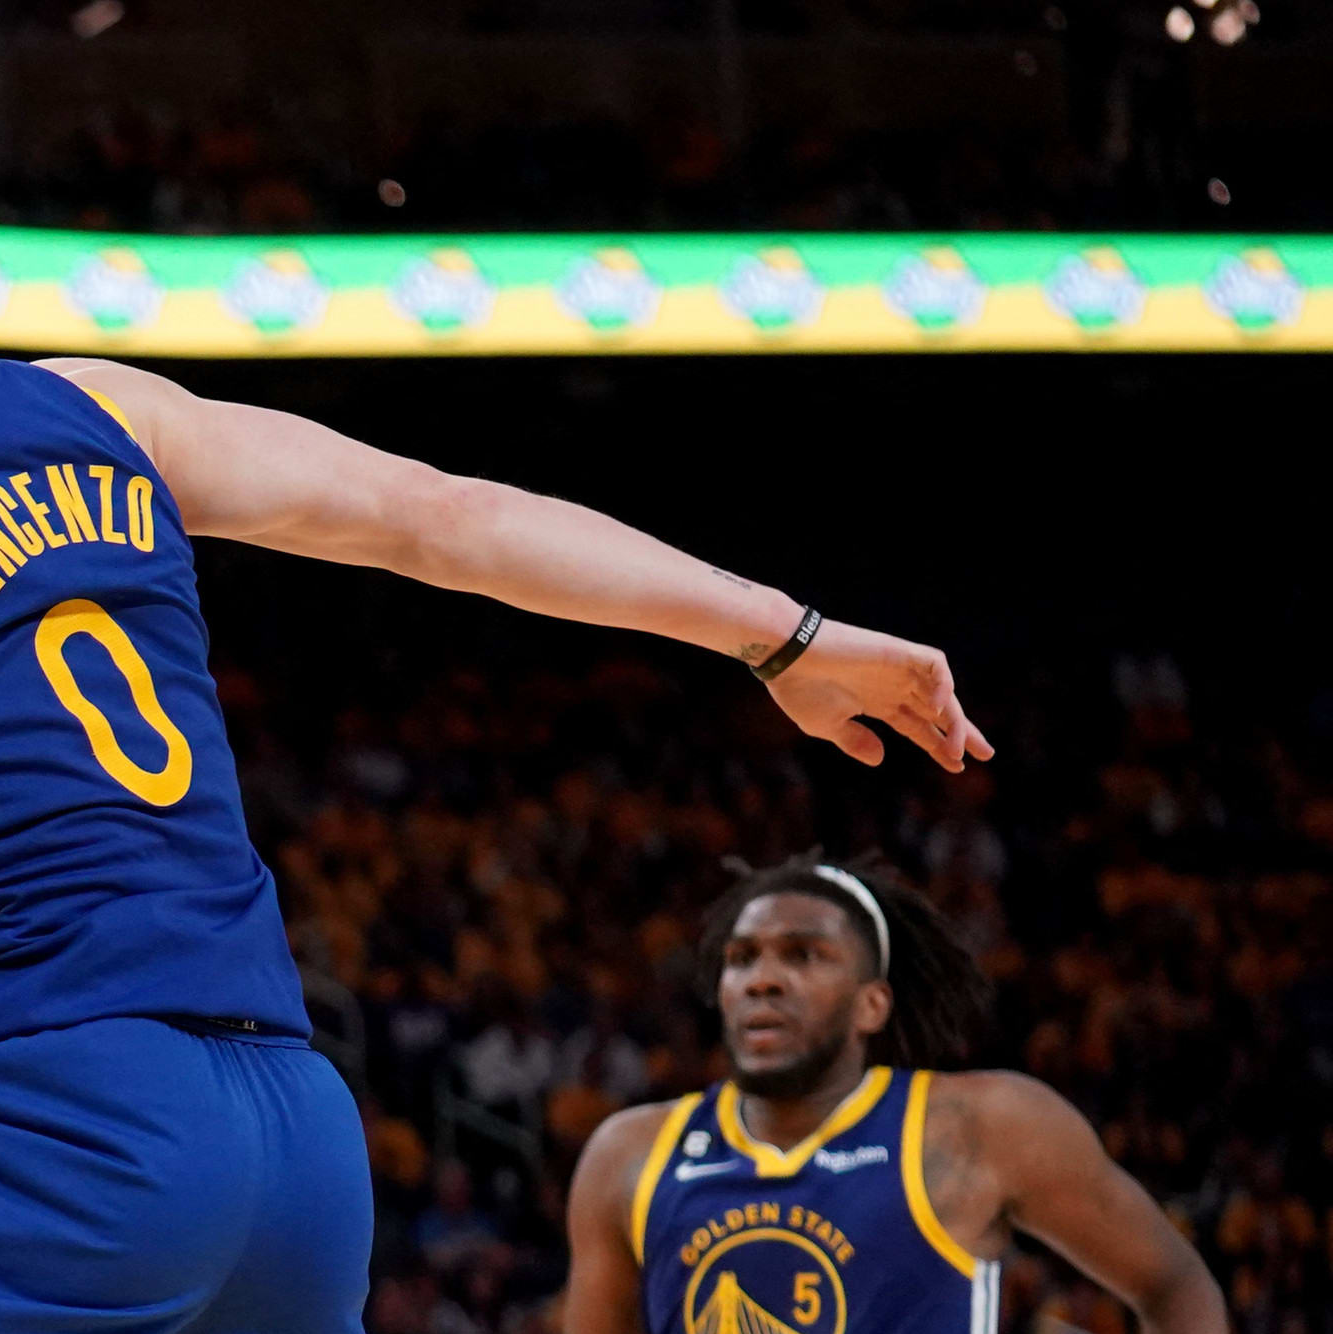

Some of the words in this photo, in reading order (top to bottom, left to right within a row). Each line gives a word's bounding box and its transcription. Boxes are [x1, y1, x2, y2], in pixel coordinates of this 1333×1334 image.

[34, 598, 193, 807] 0
[679, 1201, 781, 1266] GOLDEN
[788, 1205, 855, 1265] STATE
[792, 1272, 822, 1326] 5
